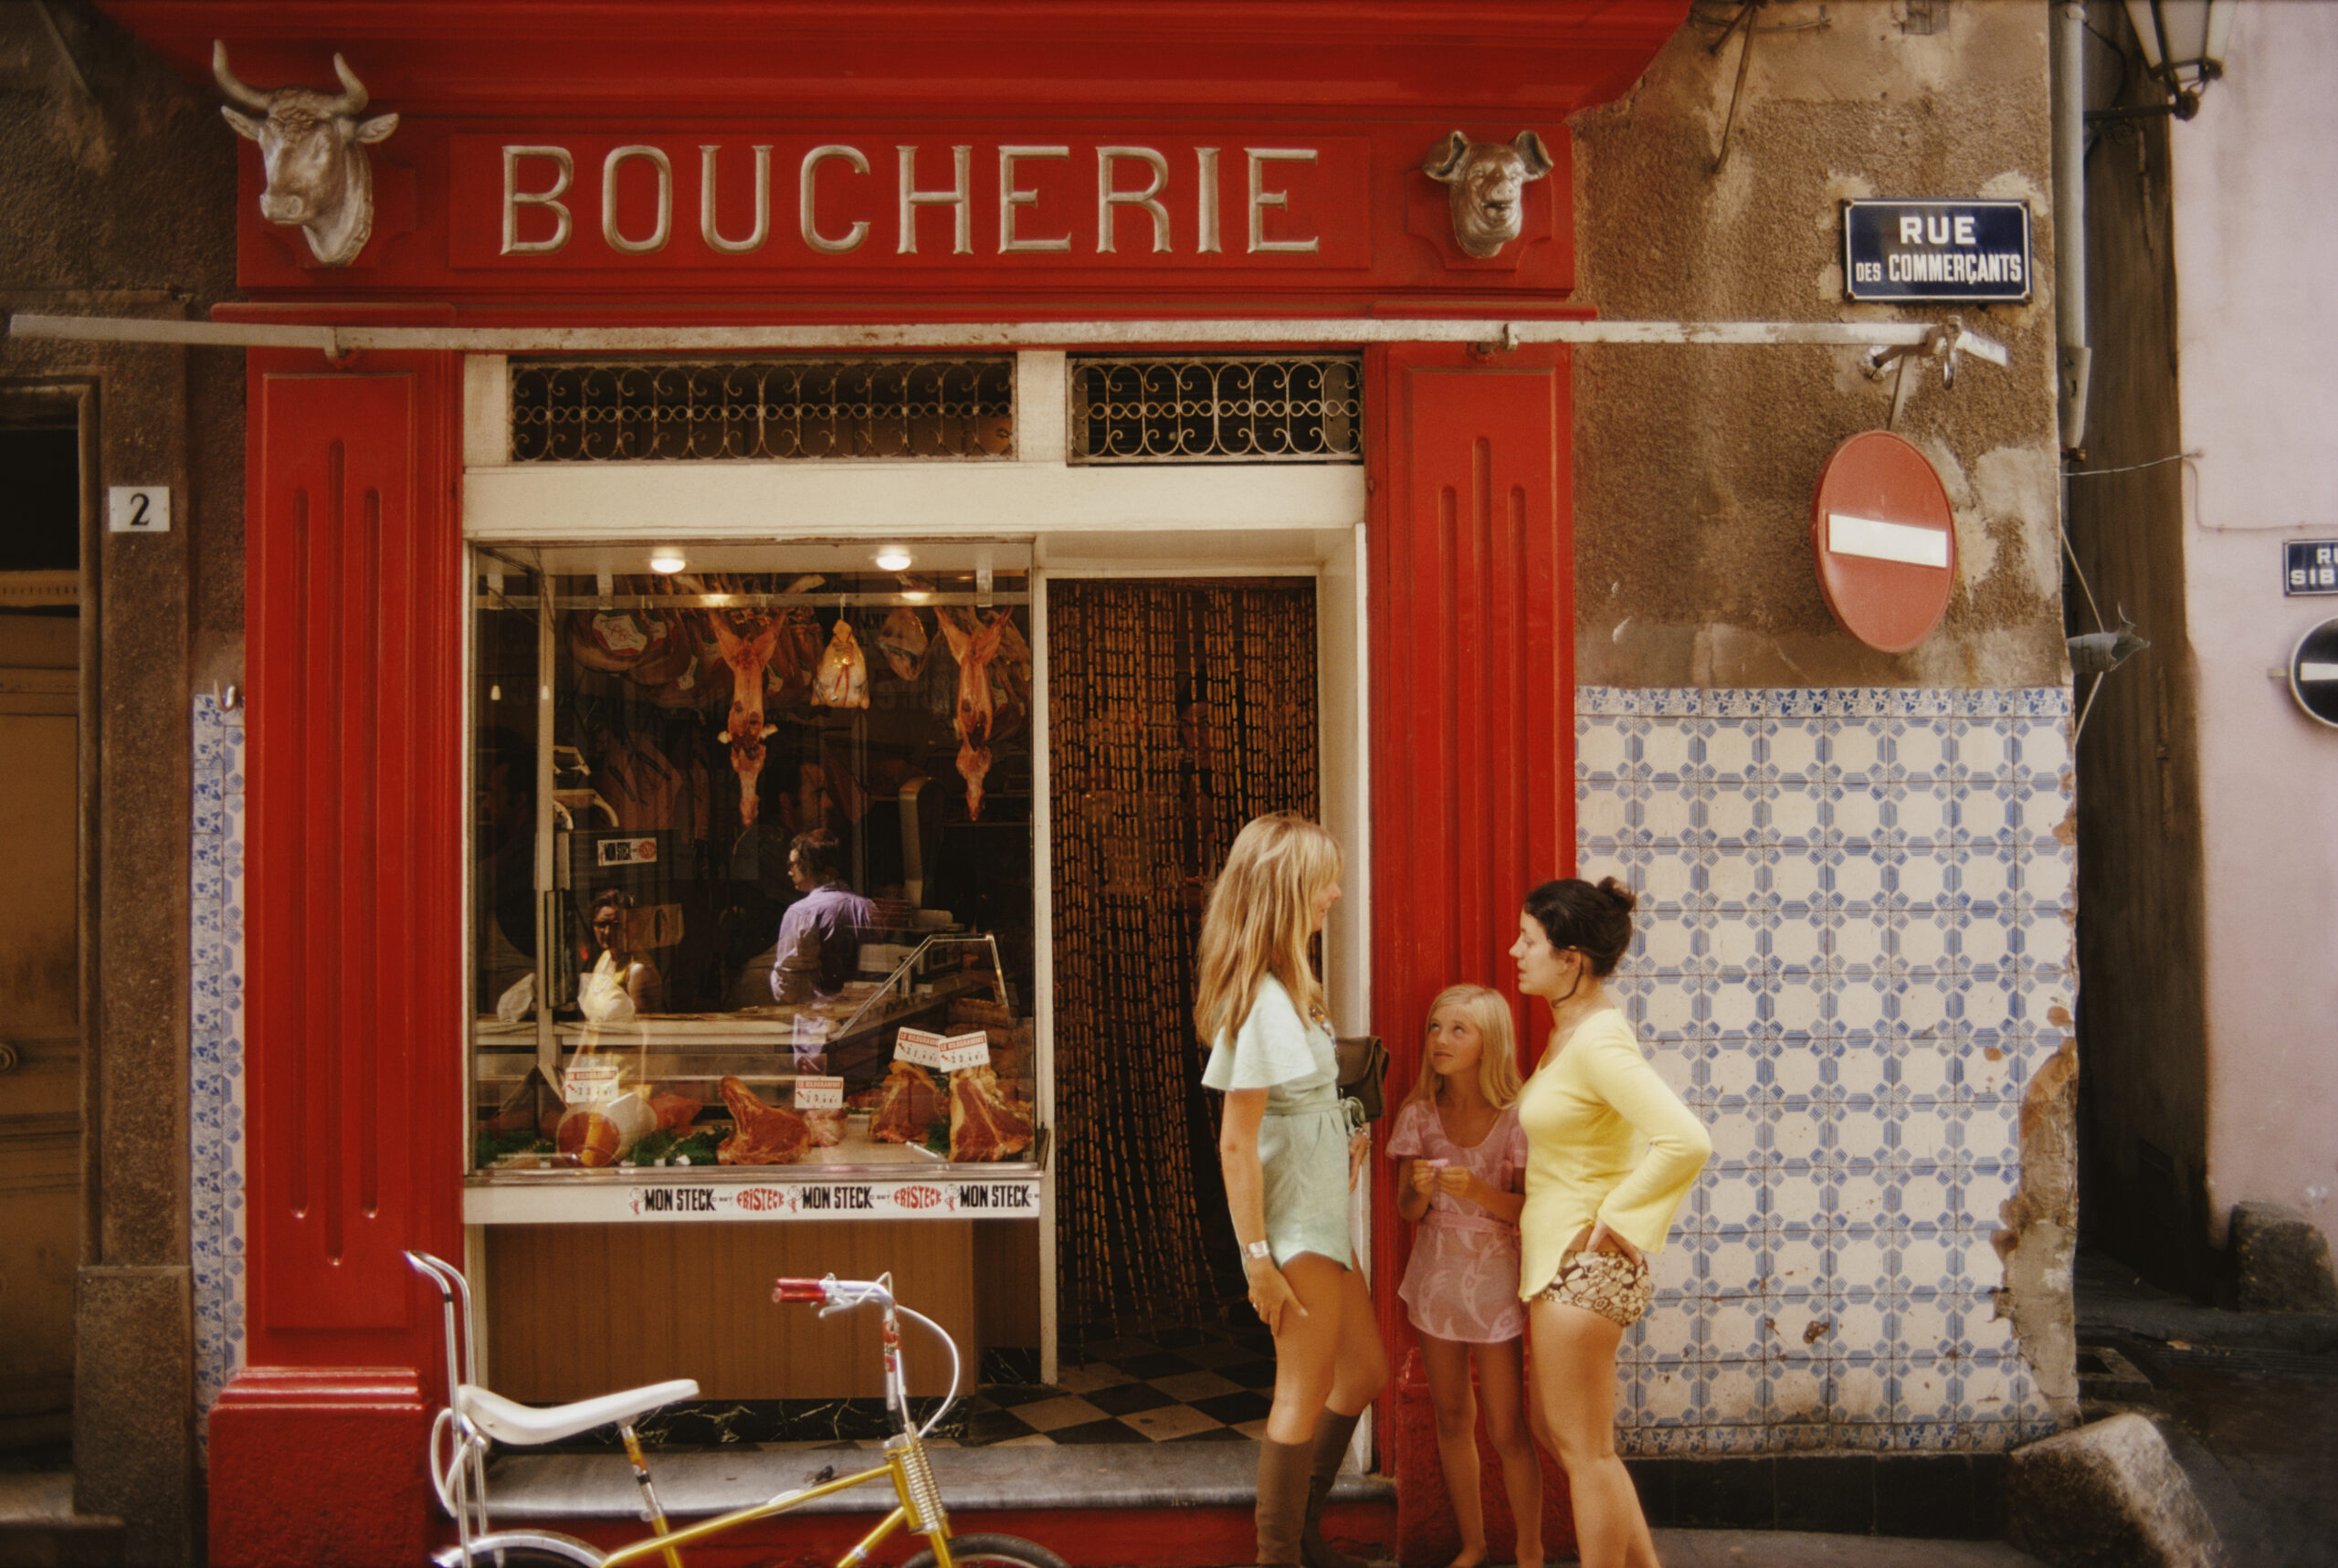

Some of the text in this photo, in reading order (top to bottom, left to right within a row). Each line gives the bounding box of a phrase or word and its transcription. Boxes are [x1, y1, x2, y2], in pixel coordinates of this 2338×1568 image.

[500, 144, 1320, 256] BOUCHERIE
[1899, 216, 1976, 245] RUE
[1855, 253, 2022, 285] DES COMMERÇANTS
[130, 492, 151, 525] 2
[645, 1188, 673, 1211] MON
[676, 1188, 716, 1211] STECK
[802, 1185, 831, 1209] MON
[834, 1185, 874, 1209] STECK
[960, 1184, 988, 1207] MON
[992, 1184, 1031, 1207] STECK
